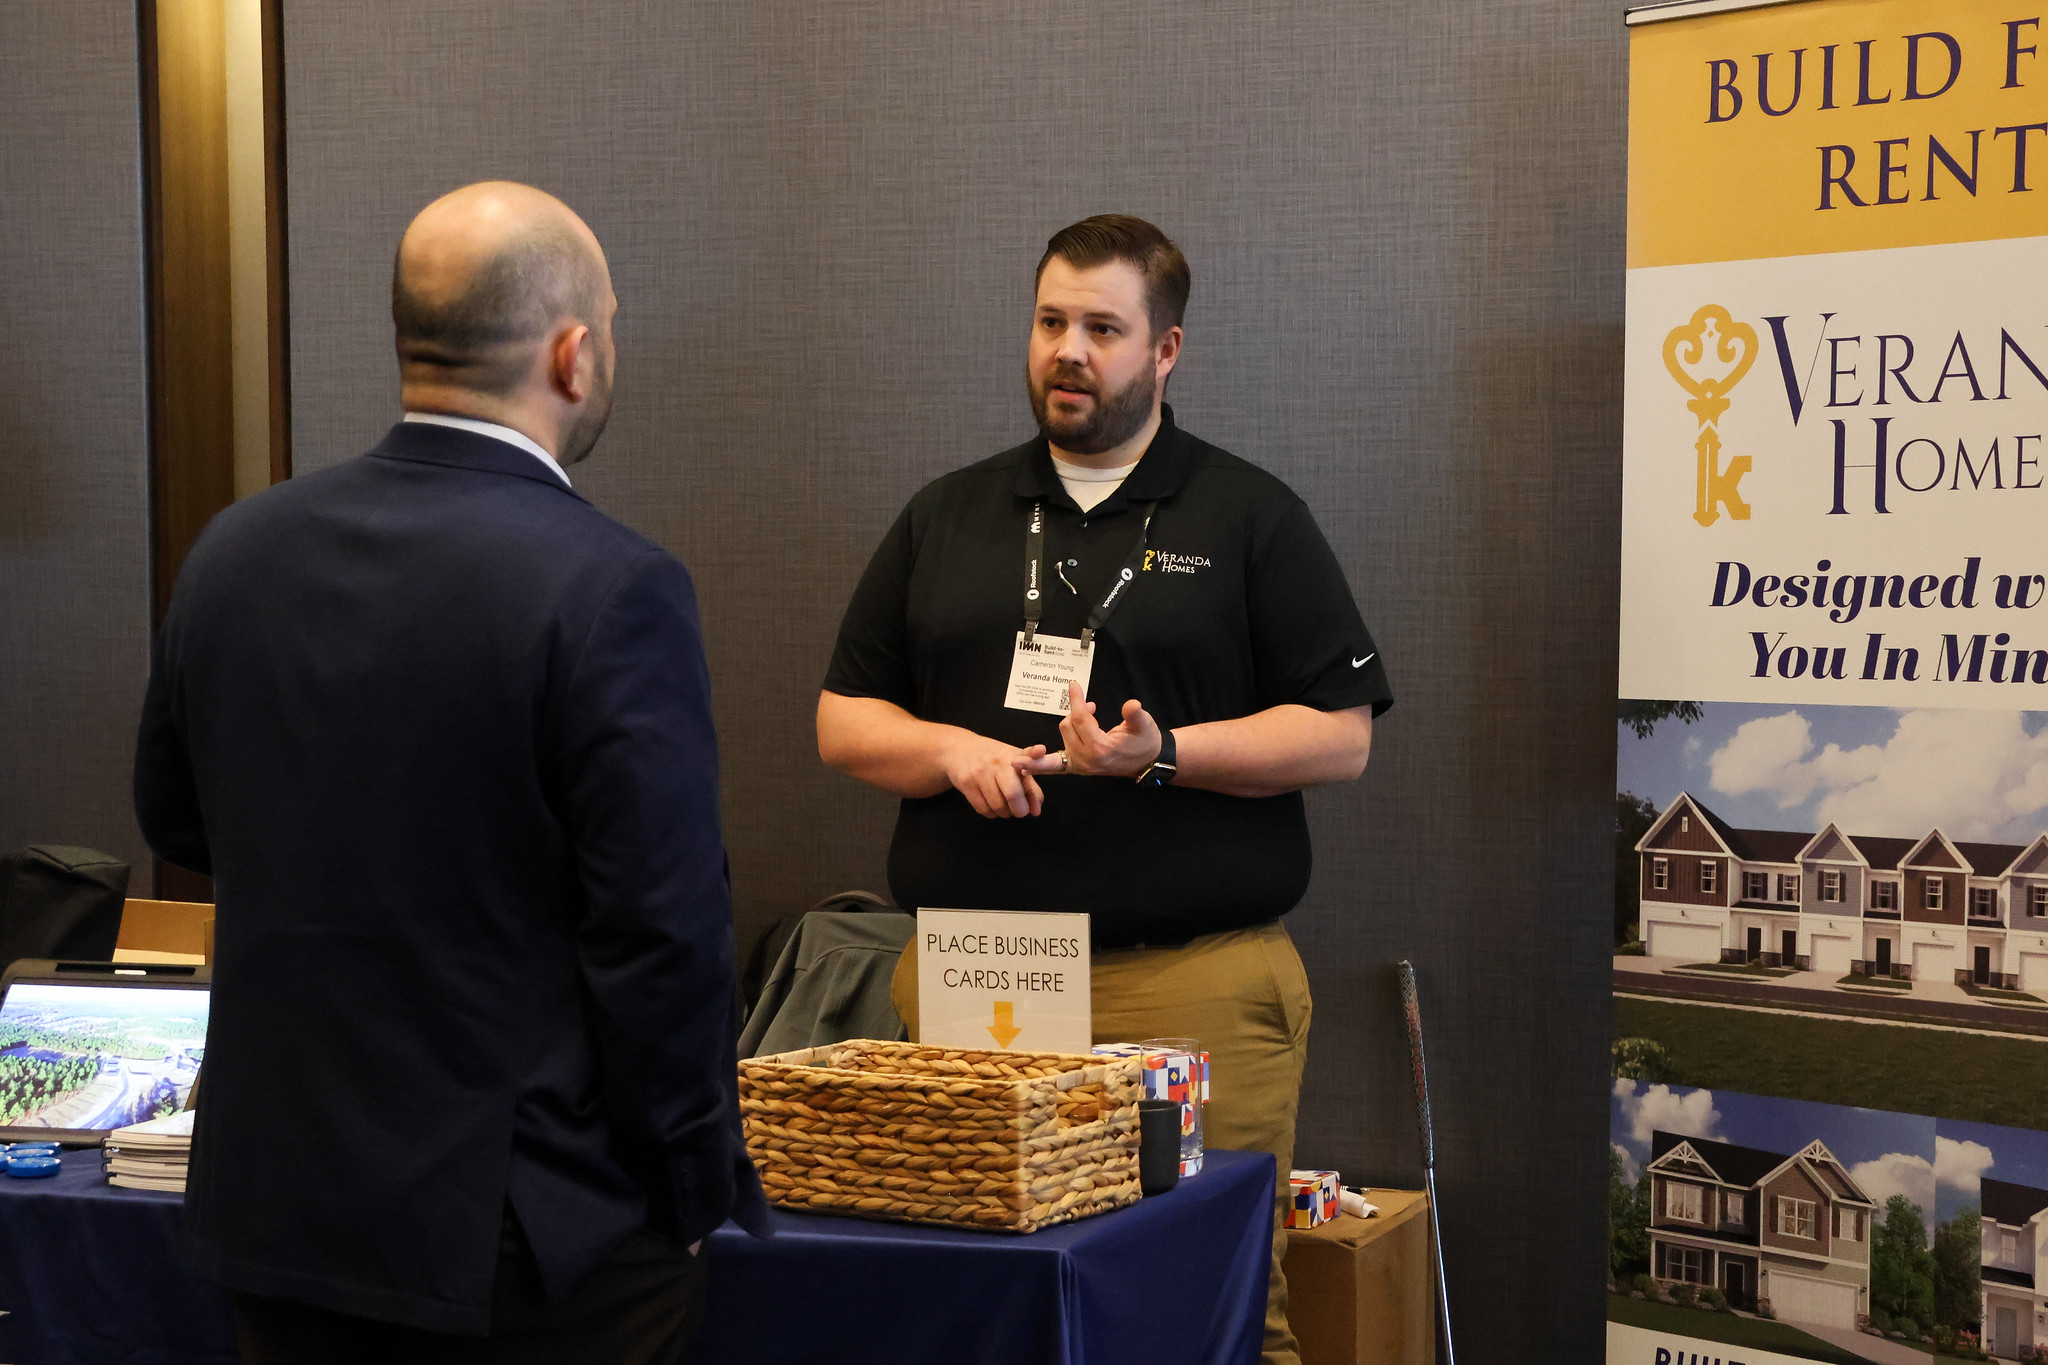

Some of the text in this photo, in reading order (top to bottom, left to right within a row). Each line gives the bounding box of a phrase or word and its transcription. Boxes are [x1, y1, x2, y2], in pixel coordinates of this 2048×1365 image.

[1704, 16, 2040, 124] BUILD F
[1814, 122, 2048, 211] RENT
[1825, 417, 2045, 515] HOME
[1030, 559, 1038, 589] Roofstock
[1156, 550, 1211, 568] VERANDA
[1161, 561, 1196, 574] HOMES
[1102, 578, 1125, 609] Roofstock
[1708, 556, 1982, 624] Designed
[1030, 659, 1075, 673] Cameron Young
[1748, 631, 2048, 685] You In Min
[1022, 671, 1051, 682] Veranda
[927, 933, 1079, 958] PLACE BUSINESS
[943, 968, 1064, 992] CARDS HERE
